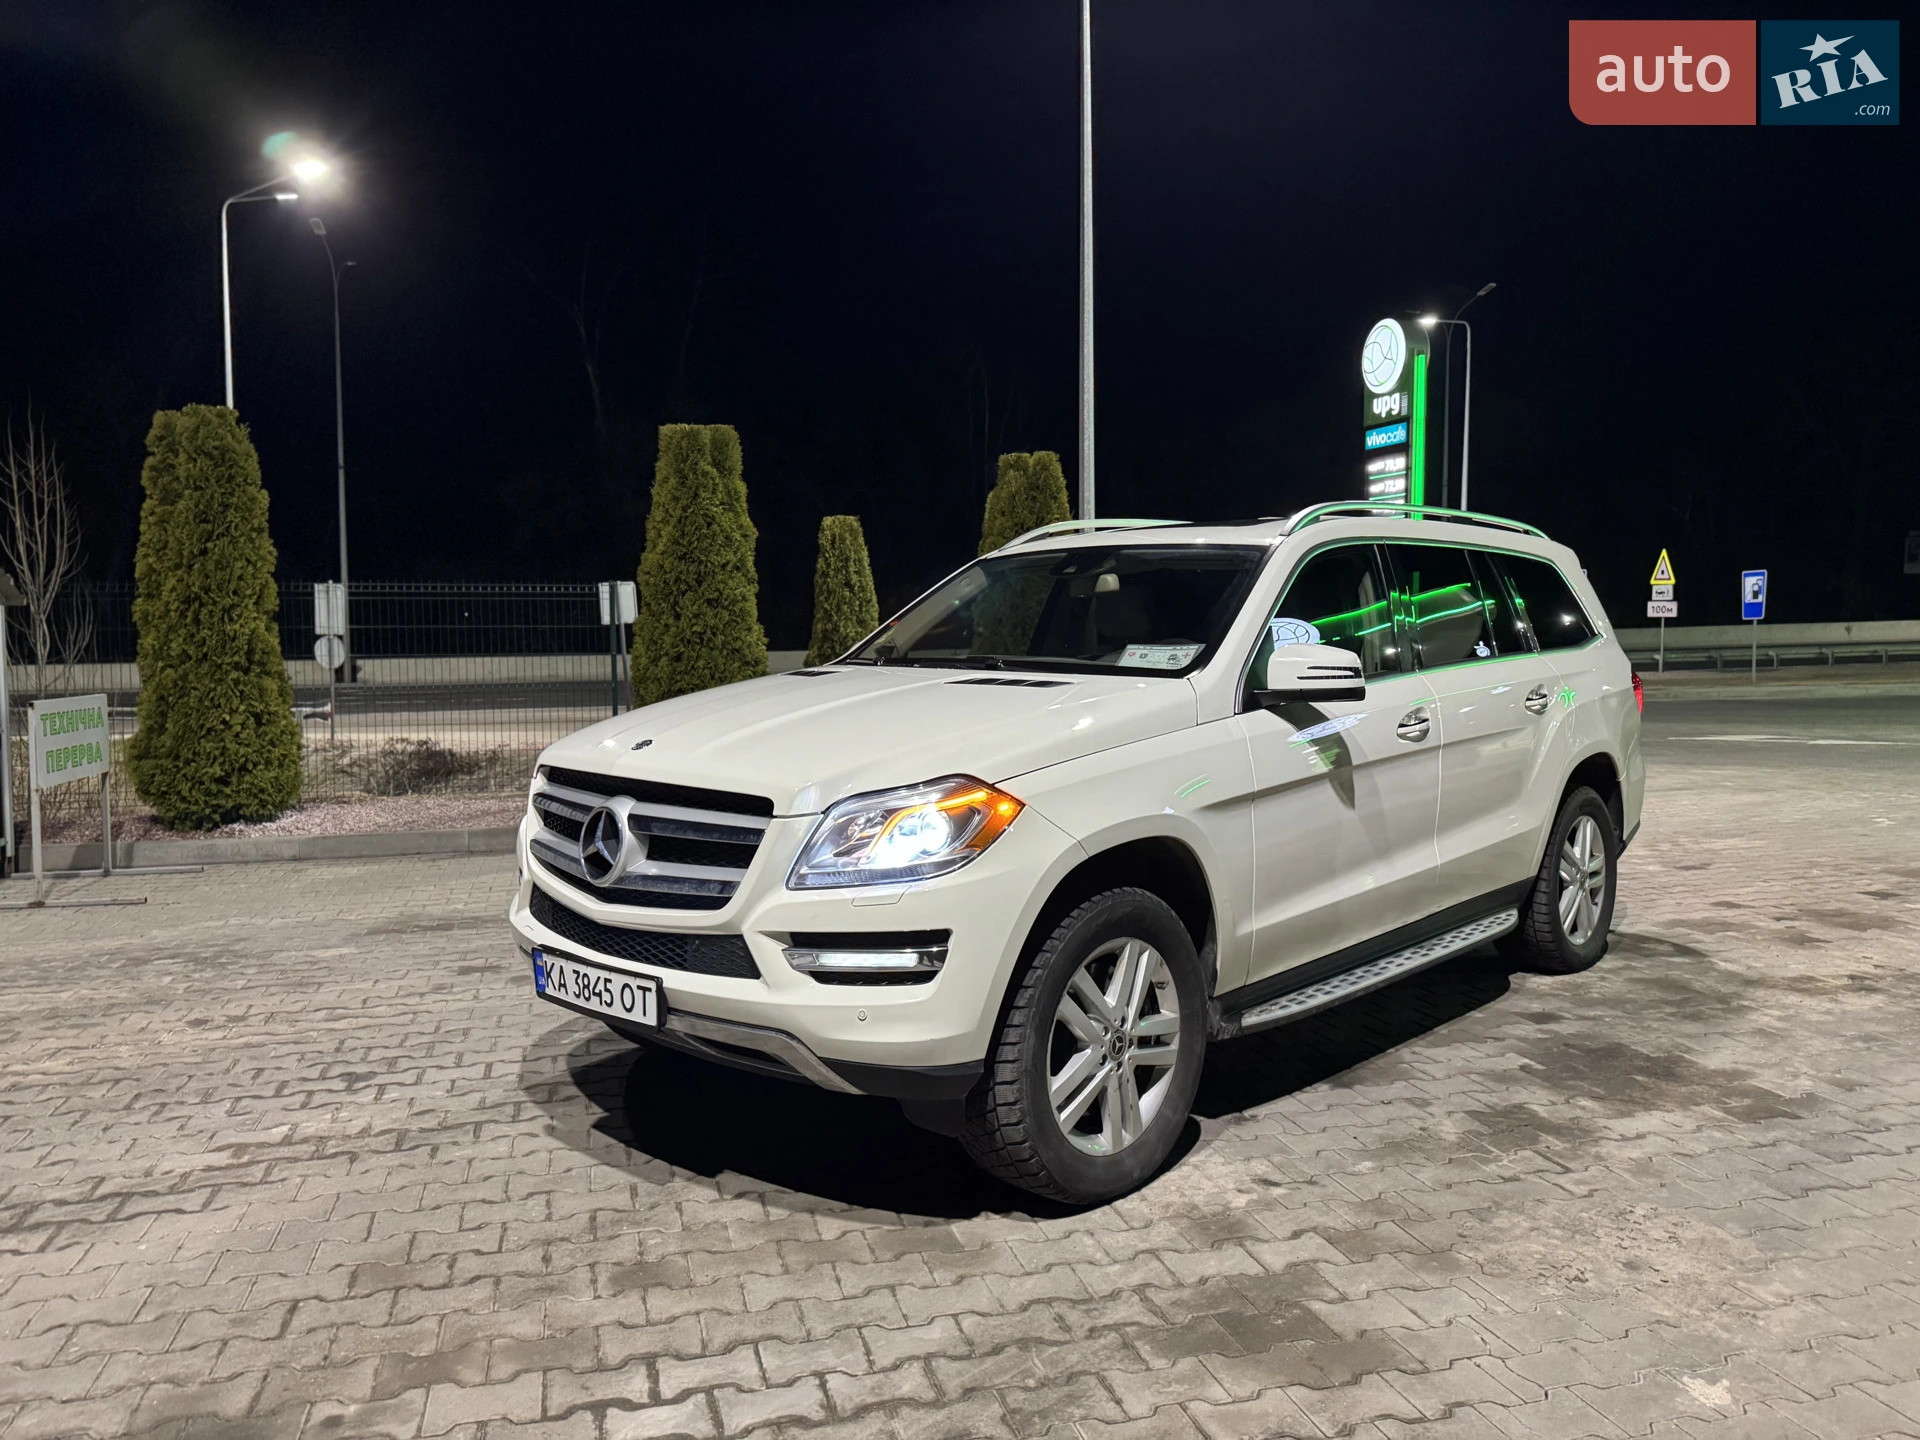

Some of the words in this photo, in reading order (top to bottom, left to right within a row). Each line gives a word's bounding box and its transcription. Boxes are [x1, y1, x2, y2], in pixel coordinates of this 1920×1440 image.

[1372, 392, 1400, 418] upg
[40, 706, 104, 737] ТЕХНІЧНА
[45, 741, 103, 774] ПЕРЕРВА
[544, 960, 569, 995] KA
[572, 969, 614, 1008] 3845
[620, 982, 653, 1017] OT
